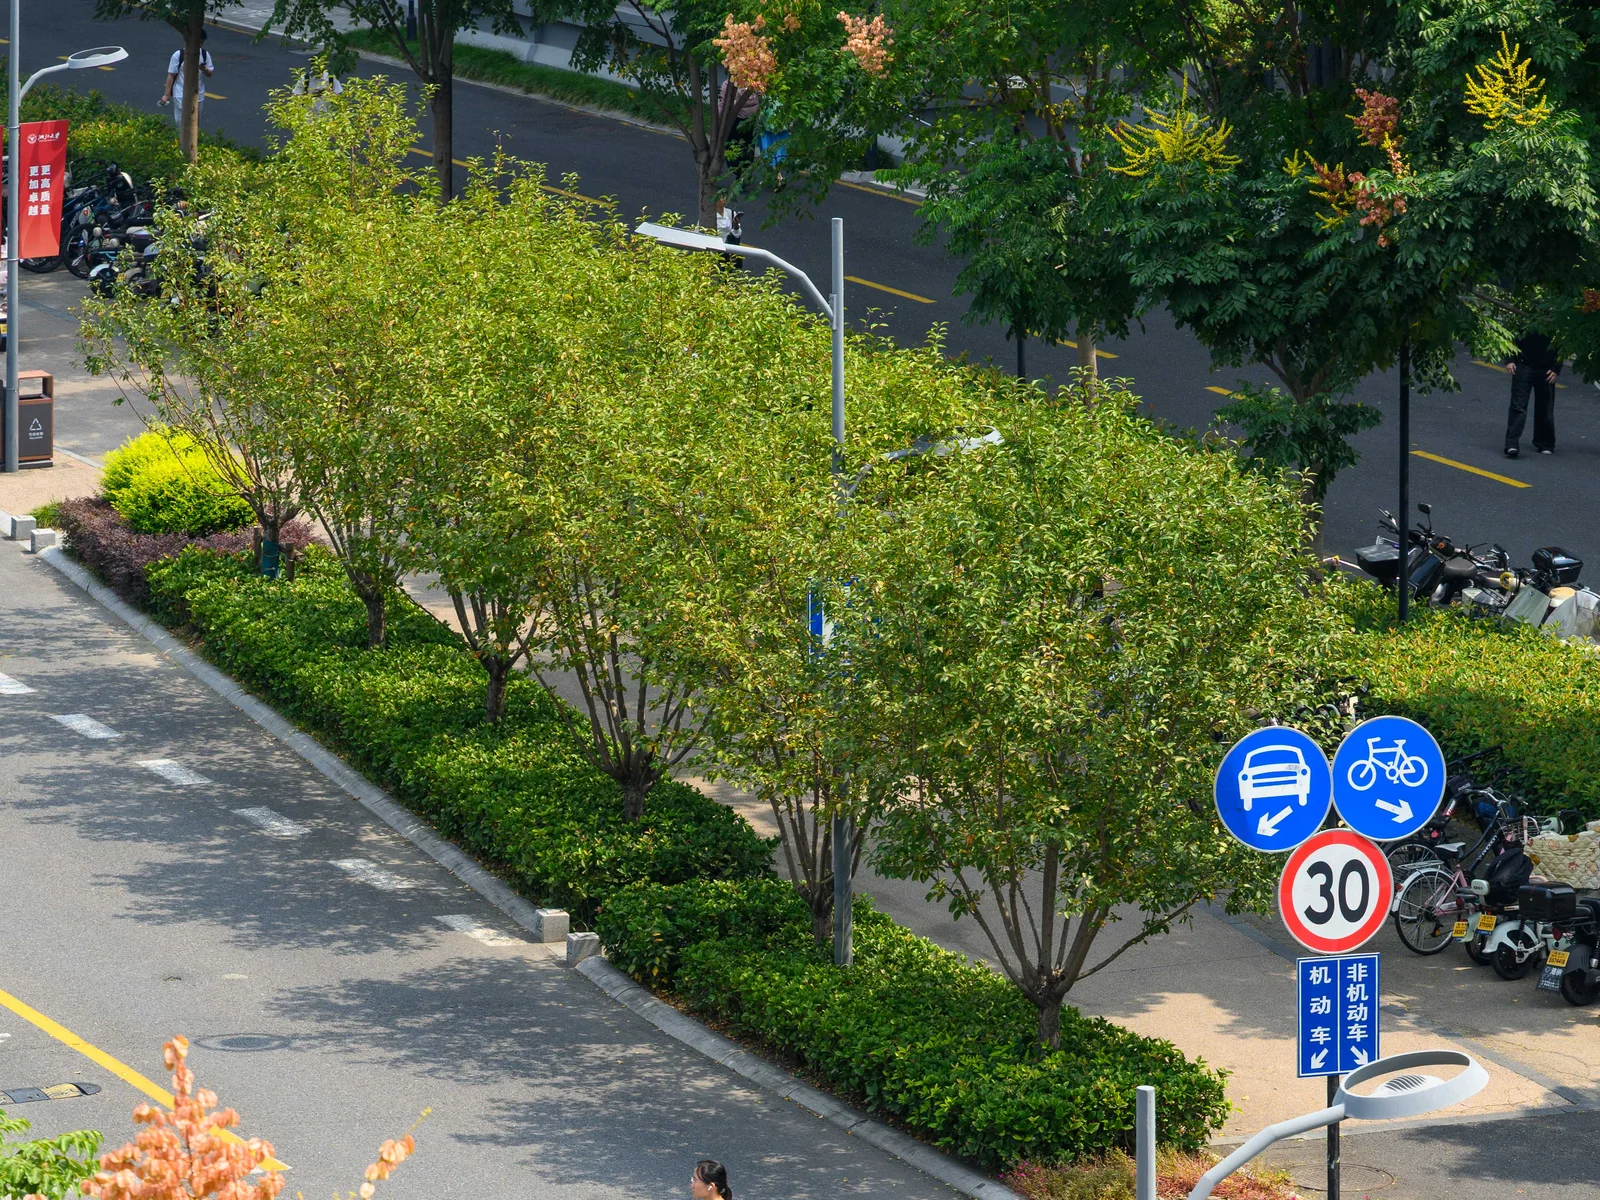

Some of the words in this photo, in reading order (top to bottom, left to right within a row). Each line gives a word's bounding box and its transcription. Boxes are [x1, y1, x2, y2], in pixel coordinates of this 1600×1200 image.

[28, 166, 39, 216] 更加卓越
[40, 165, 51, 215] 更高质量
[1304, 859, 1370, 925] 30
[1309, 966, 1332, 1045] 机动车
[1346, 963, 1369, 1043] 非机动车
